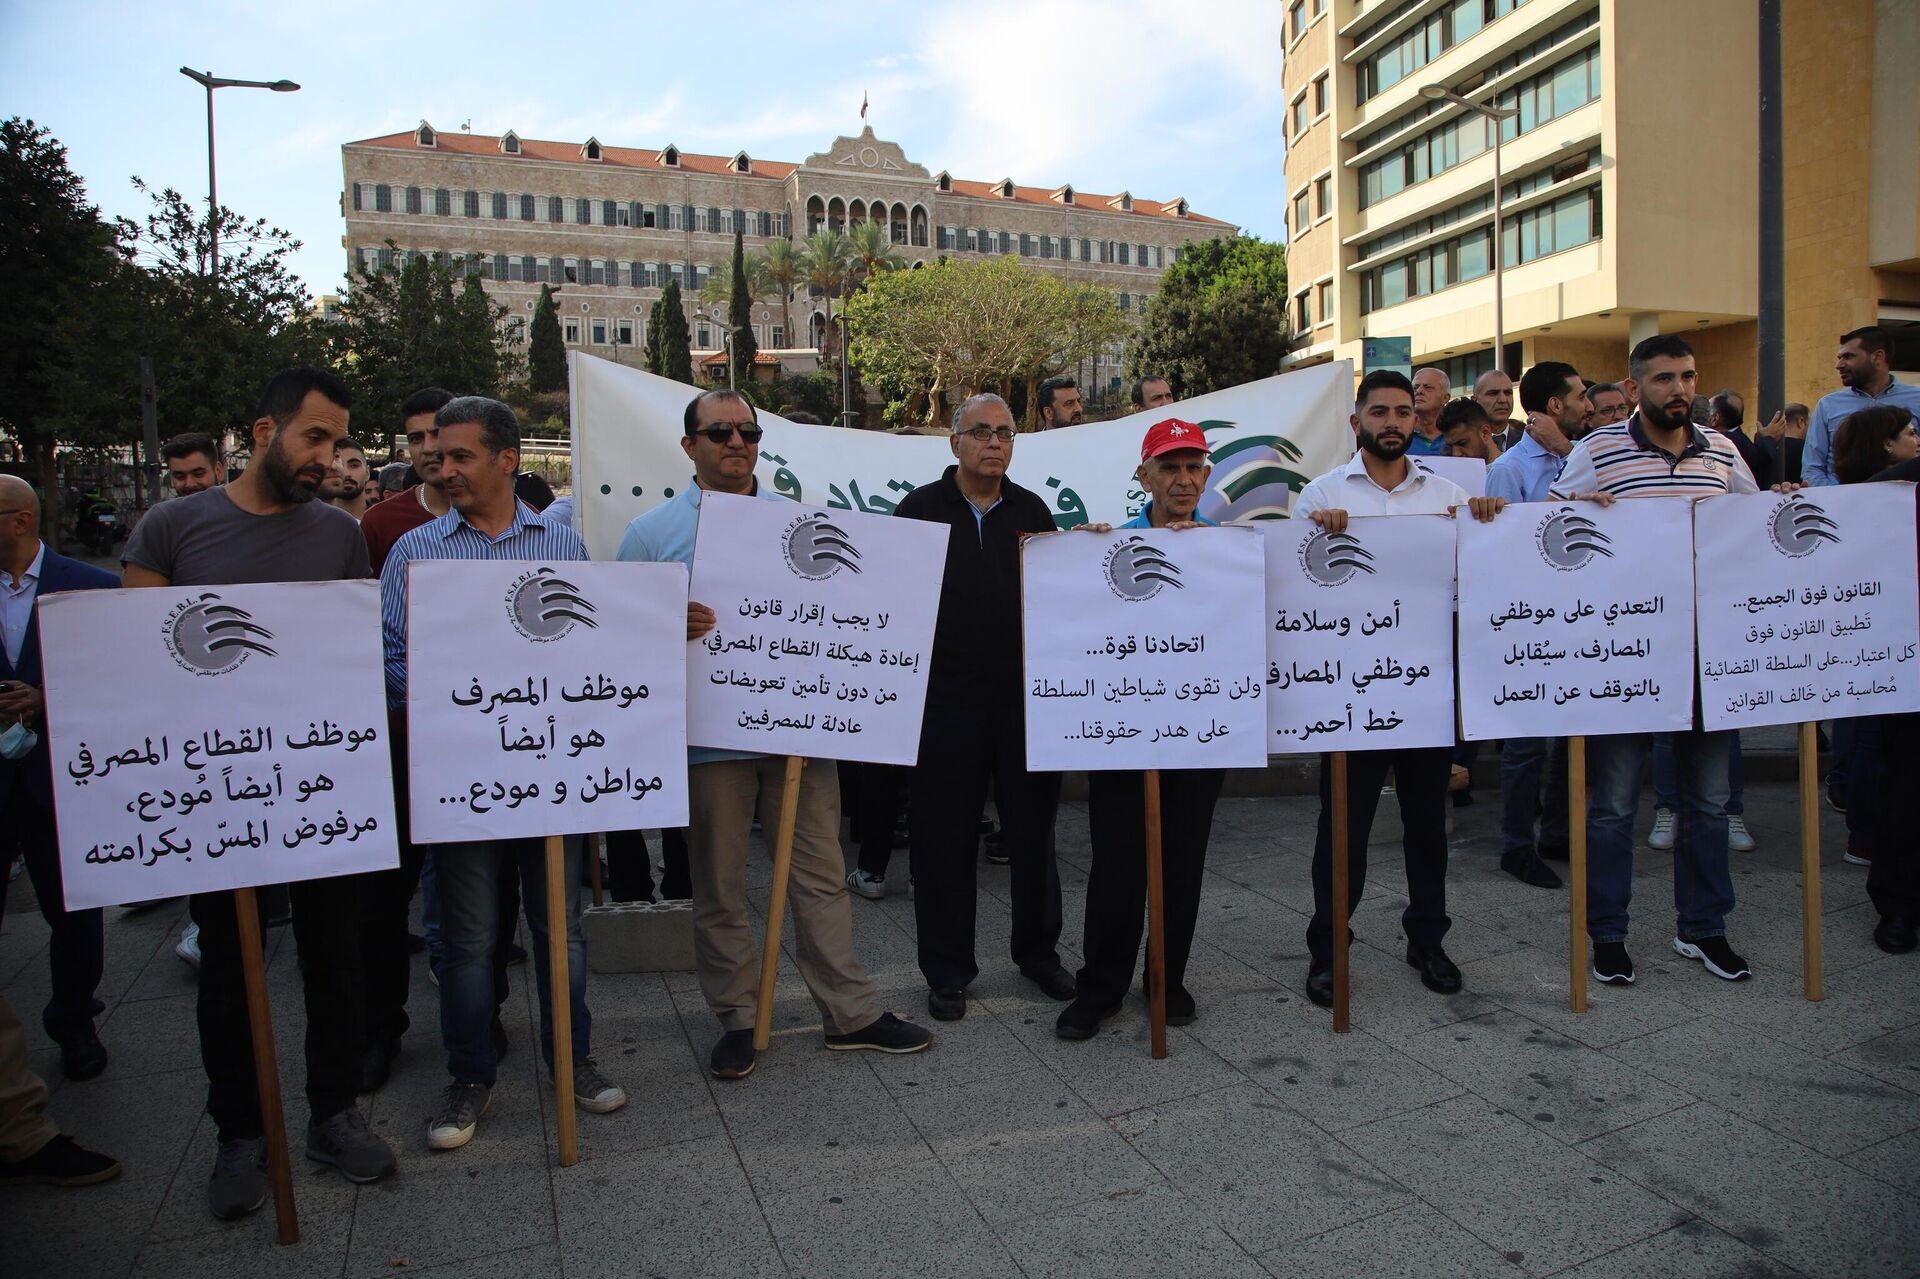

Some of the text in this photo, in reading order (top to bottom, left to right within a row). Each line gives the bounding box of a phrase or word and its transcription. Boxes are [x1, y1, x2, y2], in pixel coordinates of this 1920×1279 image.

[505, 571, 536, 602] F.S.E.B.L.
[1733, 582, 1881, 613] القانون فوق الجميع...
[162, 598, 198, 634] F.S.E.B.L.
[739, 598, 889, 631] لا يجب إقرار قانون
[1275, 600, 1400, 636] أمن وسلامة
[1489, 596, 1663, 631] التعدي على موظفي
[1746, 624, 1774, 643] فوق
[1781, 620, 1825, 640] القانون
[703, 630, 919, 673] إعادة هيكلة القطاع المصرفي،
[1086, 635, 1205, 660] اتحادنا قوة...
[1574, 638, 1650, 662] المصارف،
[1766, 653, 1811, 671] السلطة
[1896, 643, 1916, 663] كل
[1266, 656, 1429, 694] موظفي المصارف
[1704, 659, 1759, 681] القضائية
[452, 673, 649, 713] موظف المصرف
[711, 670, 897, 705] من دون تأمين تعويضات
[1032, 676, 1260, 703] ولن تقوى شياطين السلطة
[1494, 679, 1660, 705] بالتوقف عن العمل
[1726, 690, 1774, 713] القوانين
[1822, 688, 1840, 703] من
[498, 714, 605, 759] هو أيضاً
[738, 709, 862, 733] عادلة للمصرفيين
[1065, 719, 1229, 744] على هدر حقوقنا...
[1277, 703, 1403, 740] خط أحمر...
[69, 720, 376, 787] موظف القطاع المصرفي
[222, 764, 282, 807] أيضاً
[296, 774, 334, 802] هو
[440, 767, 662, 813] مواطن و مودع...
[85, 809, 377, 867] مرفوض المسّ بكرامته
